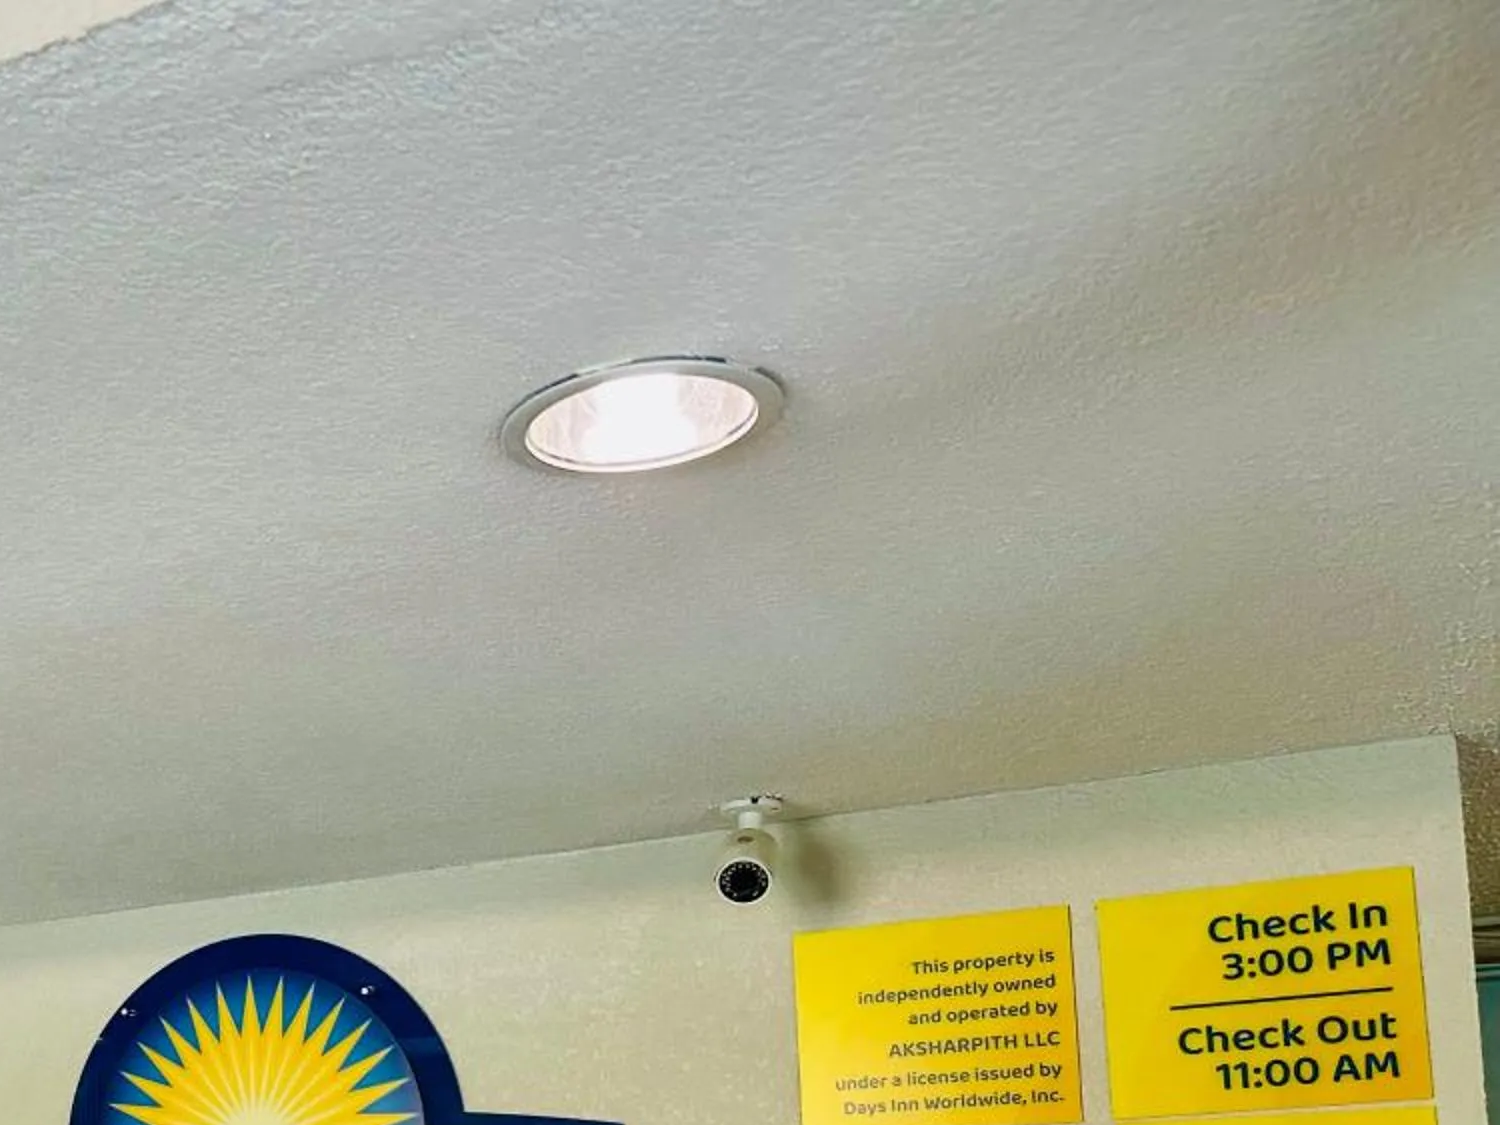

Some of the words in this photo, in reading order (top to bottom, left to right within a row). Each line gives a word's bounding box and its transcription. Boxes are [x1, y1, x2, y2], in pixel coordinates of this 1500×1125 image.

[1207, 904, 1336, 943] Check
[1348, 902, 1388, 930] In
[912, 959, 949, 975] This
[953, 951, 1035, 974] property
[1039, 949, 1055, 963] is
[1221, 946, 1314, 980] 3:00
[1326, 938, 1392, 971] PM
[858, 980, 988, 1005] independently
[994, 974, 1056, 993] owned
[908, 1010, 941, 1025] and
[946, 1001, 1030, 1024] operated
[1035, 1000, 1058, 1017] by
[889, 1034, 1018, 1058] AKSHARPITH
[1023, 1031, 1060, 1047] LLC
[1178, 1018, 1306, 1055] Check
[1317, 1012, 1398, 1044] Out
[835, 1074, 888, 1091] under
[890, 1076, 901, 1087] a
[907, 1070, 970, 1087] license
[974, 1064, 1034, 1082] issued
[1039, 1062, 1063, 1079] by
[1215, 1056, 1319, 1090] 11:00
[1333, 1051, 1401, 1083] AM
[844, 1100, 887, 1117] Days
[890, 1100, 919, 1113] Inn
[923, 1090, 1027, 1111] Worldwide,
[1031, 1088, 1066, 1103] Inc.
